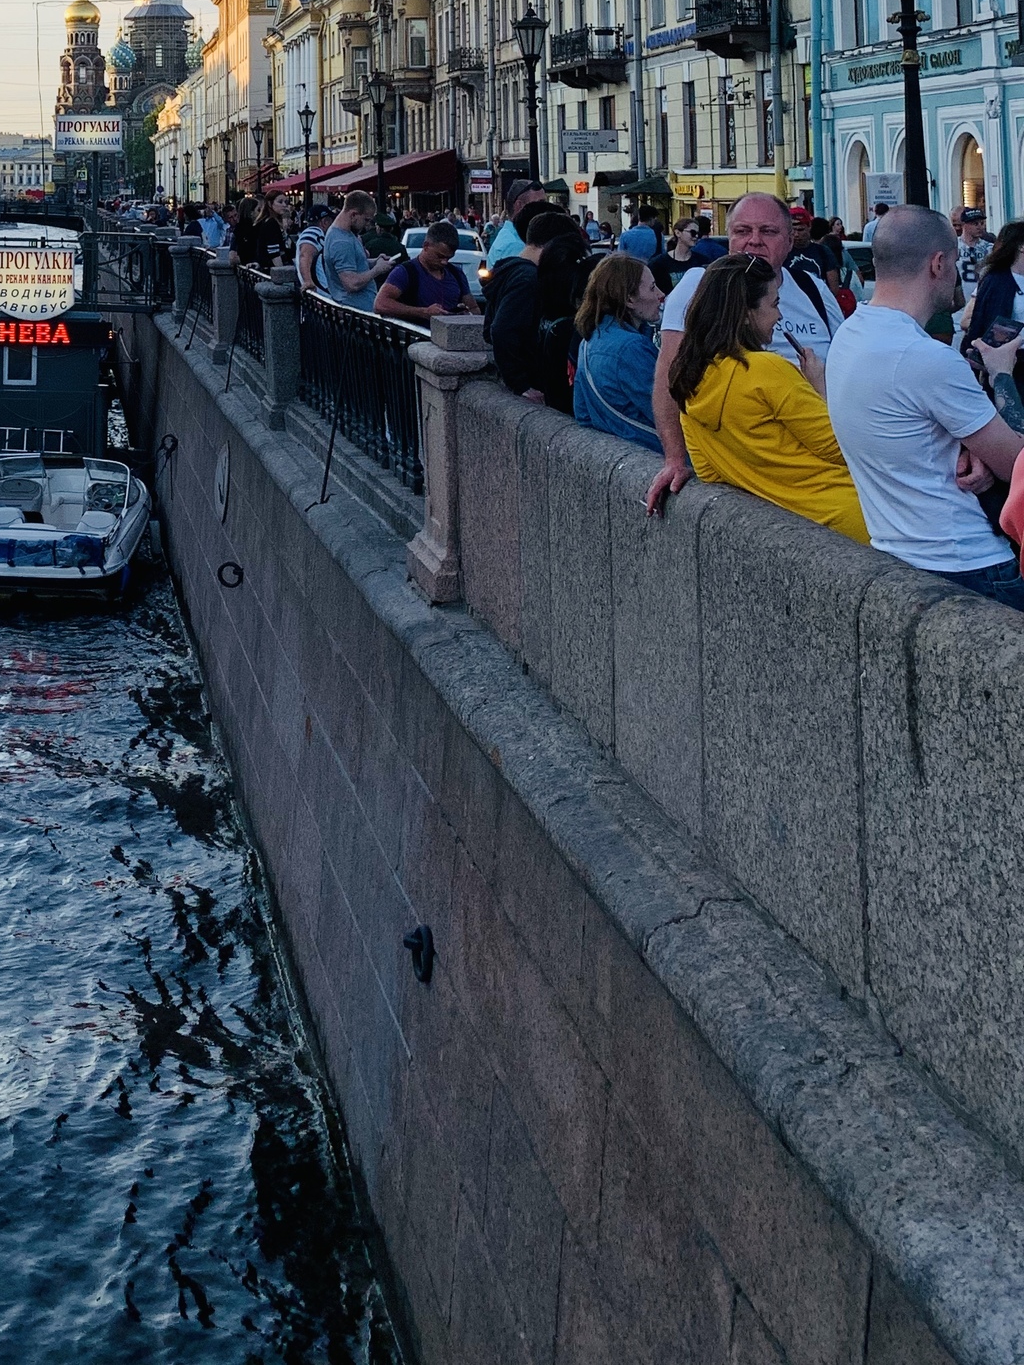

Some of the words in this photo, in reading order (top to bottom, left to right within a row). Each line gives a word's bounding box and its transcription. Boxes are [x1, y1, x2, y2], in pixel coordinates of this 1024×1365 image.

[58, 120, 120, 133] ПРОГУЛКИ
[64, 137, 85, 145] РЕКАМ
[90, 137, 120, 145] КАНАЛАМ
[5, 274, 29, 284] РЕКАМ
[30, 274, 36, 284] И
[37, 274, 73, 284] КАНАЛАМ
[0, 288, 67, 299] ВОДНЫЙ
[0, 301, 68, 314] АВТОБУС
